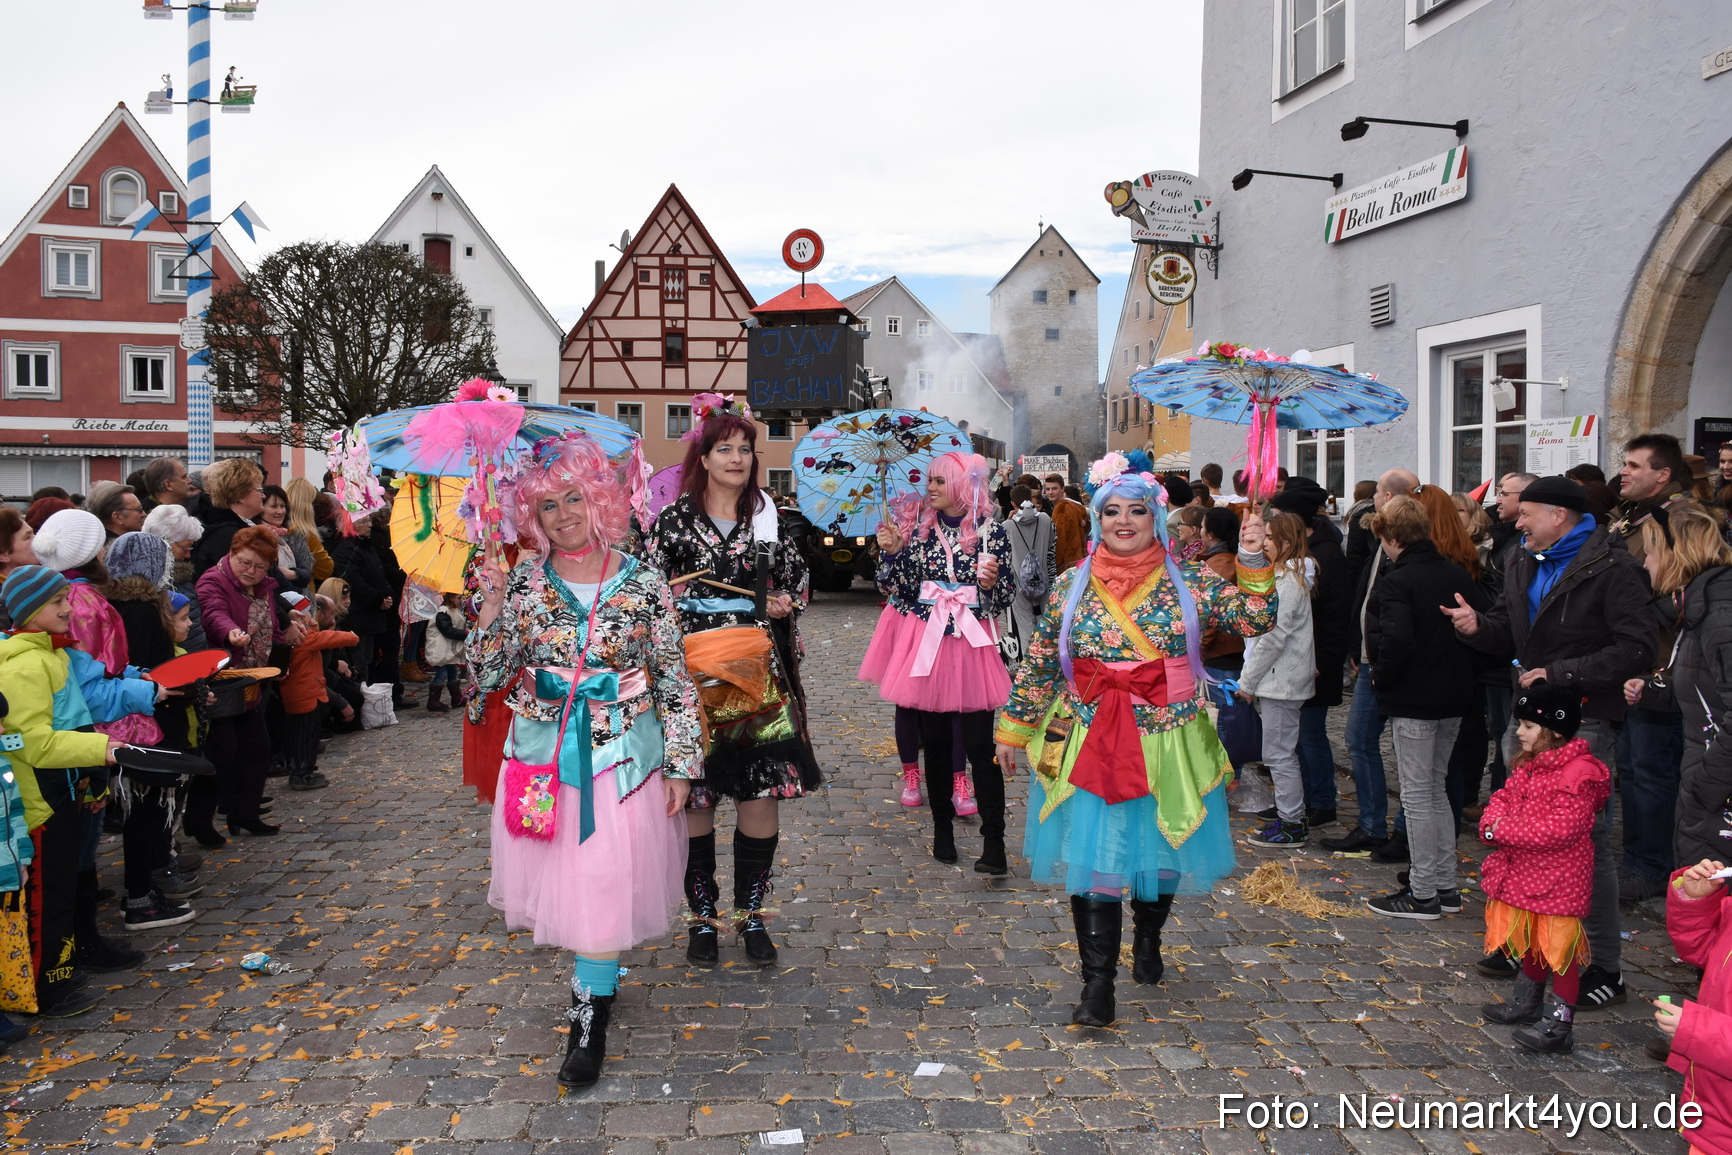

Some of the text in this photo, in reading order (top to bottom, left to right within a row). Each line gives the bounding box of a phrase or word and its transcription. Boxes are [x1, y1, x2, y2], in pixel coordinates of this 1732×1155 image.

[1151, 173, 1192, 185] Pizzeria
[1350, 161, 1438, 202] Pizzeria Café Eisdiele
[1161, 188, 1183, 199] Café
[1149, 200, 1193, 214] Eisdiele
[1345, 186, 1438, 231] Bella Roma
[1136, 229, 1169, 238] Roma
[1157, 224, 1187, 232] Bella
[760, 329, 839, 356] JVW
[753, 374, 844, 405] BACHAM
[72, 418, 171, 431] Riebe Moden
[1529, 429, 1553, 438] Bella
[1538, 437, 1564, 445] Roma
[1024, 463, 1067, 472] GREAT AGAIN
